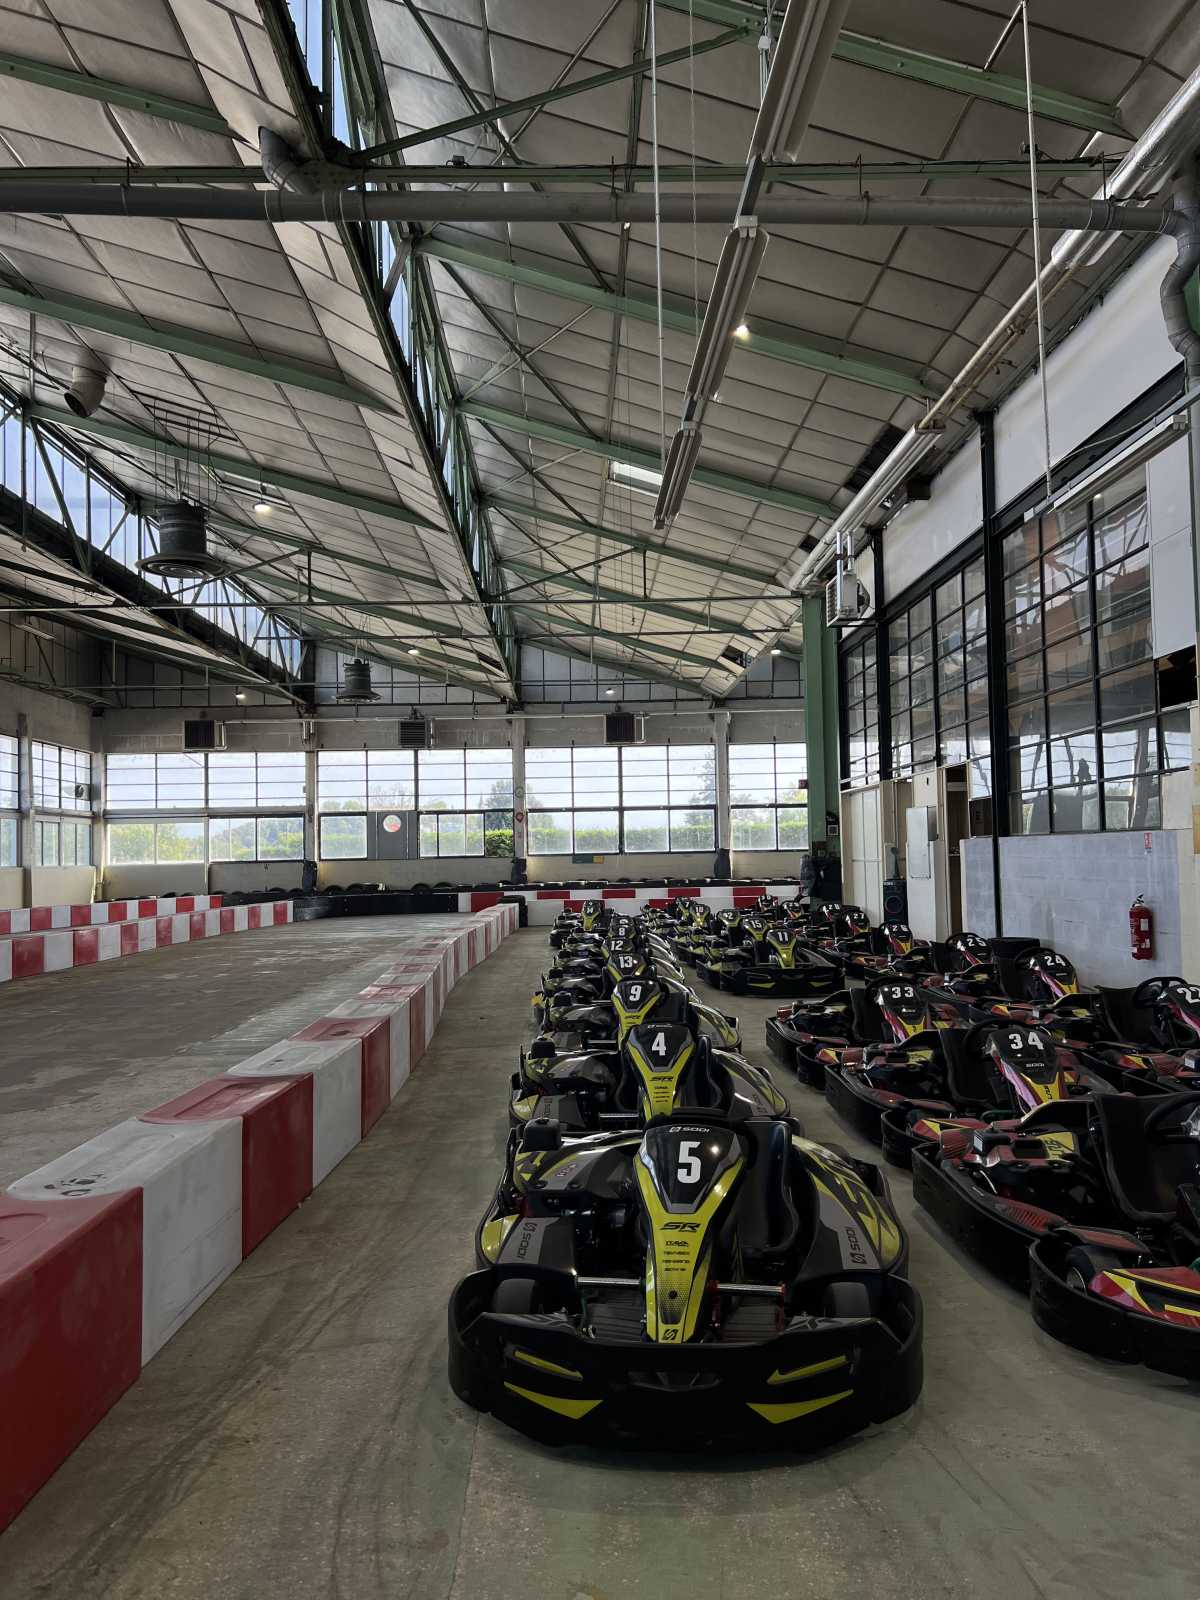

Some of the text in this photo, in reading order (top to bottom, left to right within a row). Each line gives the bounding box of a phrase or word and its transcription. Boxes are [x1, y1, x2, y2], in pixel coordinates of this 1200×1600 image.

[750, 920, 762, 929] 15
[618, 927, 626, 936] 8
[777, 931, 789, 942] 11
[610, 940, 624, 951] 12
[966, 938, 987, 947] 25
[619, 956, 633, 968] 13
[1044, 954, 1066, 966] 24
[629, 984, 642, 1002] 9
[891, 986, 914, 999] 33
[651, 1032, 667, 1056] 4
[1008, 1031, 1045, 1050] 34
[677, 1141, 702, 1184] 5
